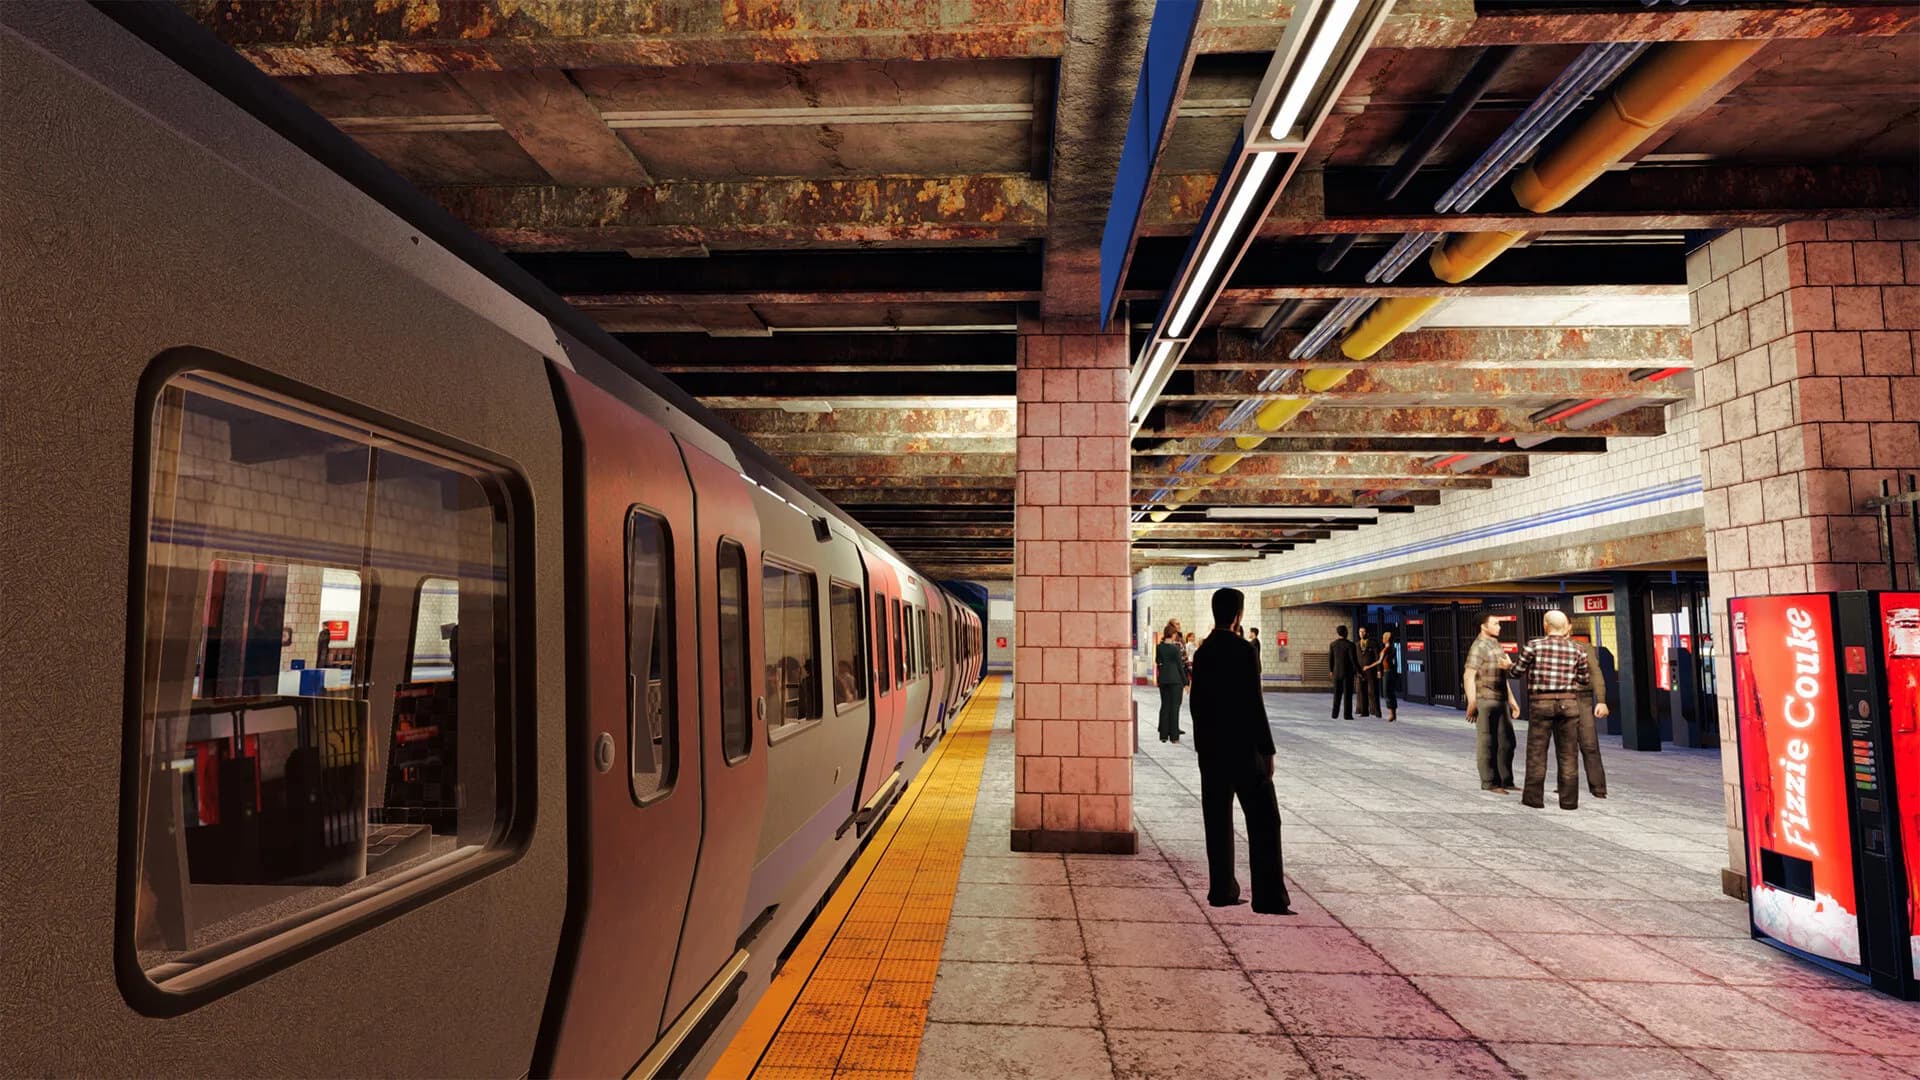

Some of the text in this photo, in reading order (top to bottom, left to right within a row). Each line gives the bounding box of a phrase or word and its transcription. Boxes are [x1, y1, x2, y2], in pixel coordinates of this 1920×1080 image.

[1587, 598, 1604, 610] Exit
[1779, 607, 1820, 857] Fizzie Couke
